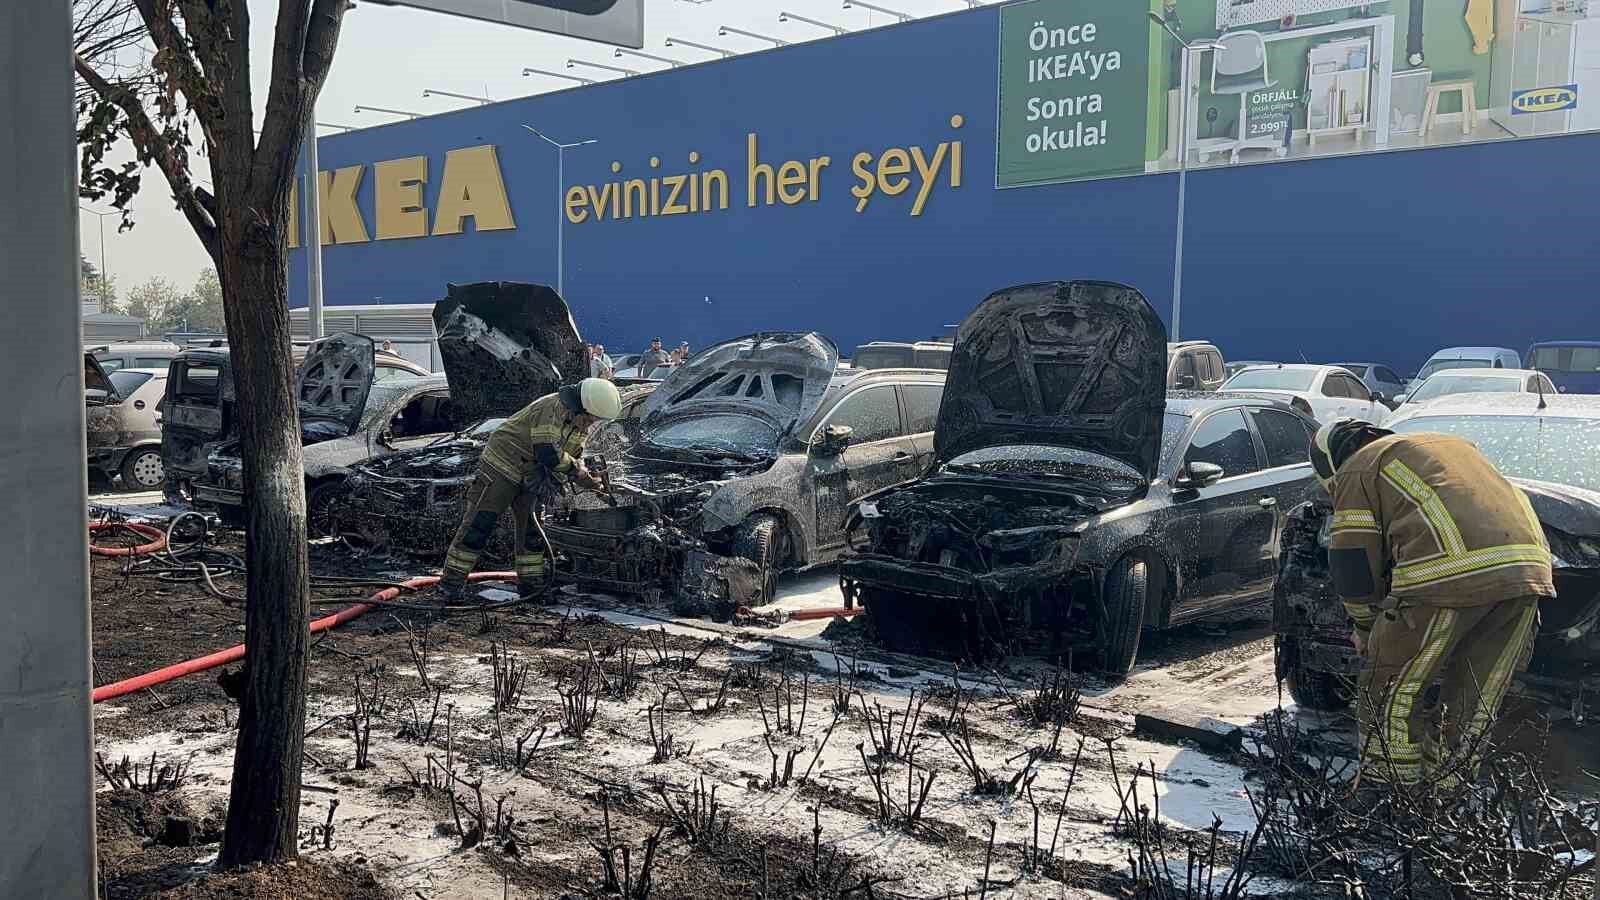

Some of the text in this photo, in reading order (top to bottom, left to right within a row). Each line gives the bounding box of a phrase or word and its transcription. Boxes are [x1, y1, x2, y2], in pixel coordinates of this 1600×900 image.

[1029, 20, 1097, 51] Önce
[1026, 93, 1102, 121] Sonra
[1252, 87, 1298, 104] ÖRFJÄLL
[1519, 92, 1569, 107] IKEA
[1025, 120, 1107, 152] okula!
[565, 151, 729, 224] evinizin
[747, 133, 831, 208] her
[851, 114, 964, 216] şeyi
